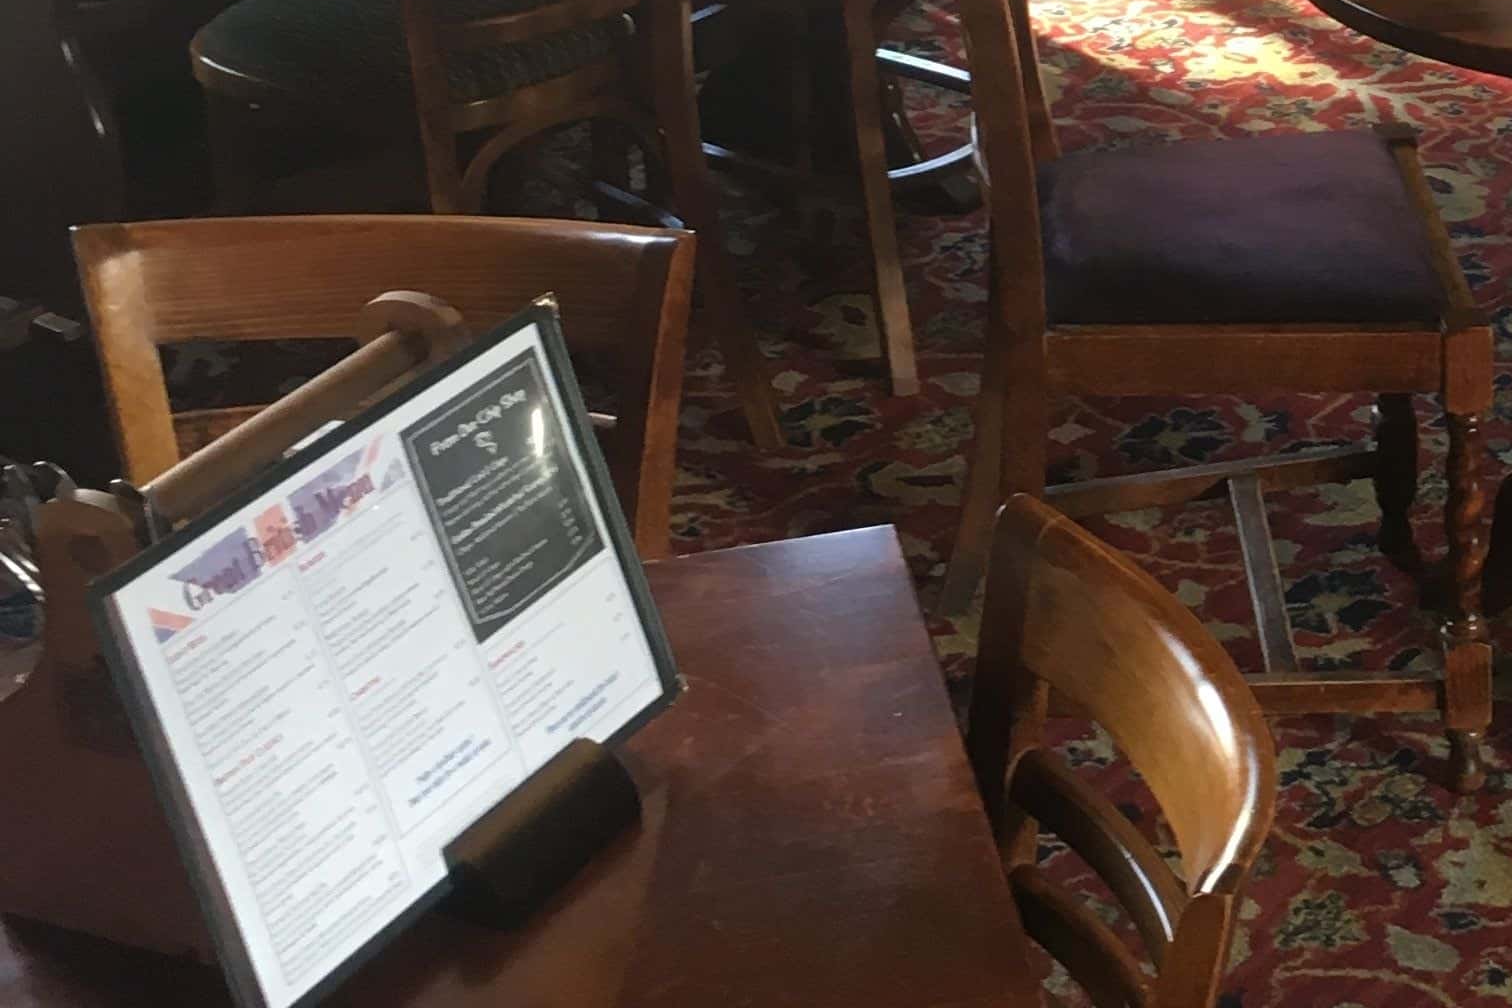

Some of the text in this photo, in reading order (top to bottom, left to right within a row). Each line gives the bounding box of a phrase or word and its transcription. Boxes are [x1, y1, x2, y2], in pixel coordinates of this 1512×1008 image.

[183, 557, 246, 612] Great
[242, 505, 318, 569] British
[314, 473, 376, 522] Menu
